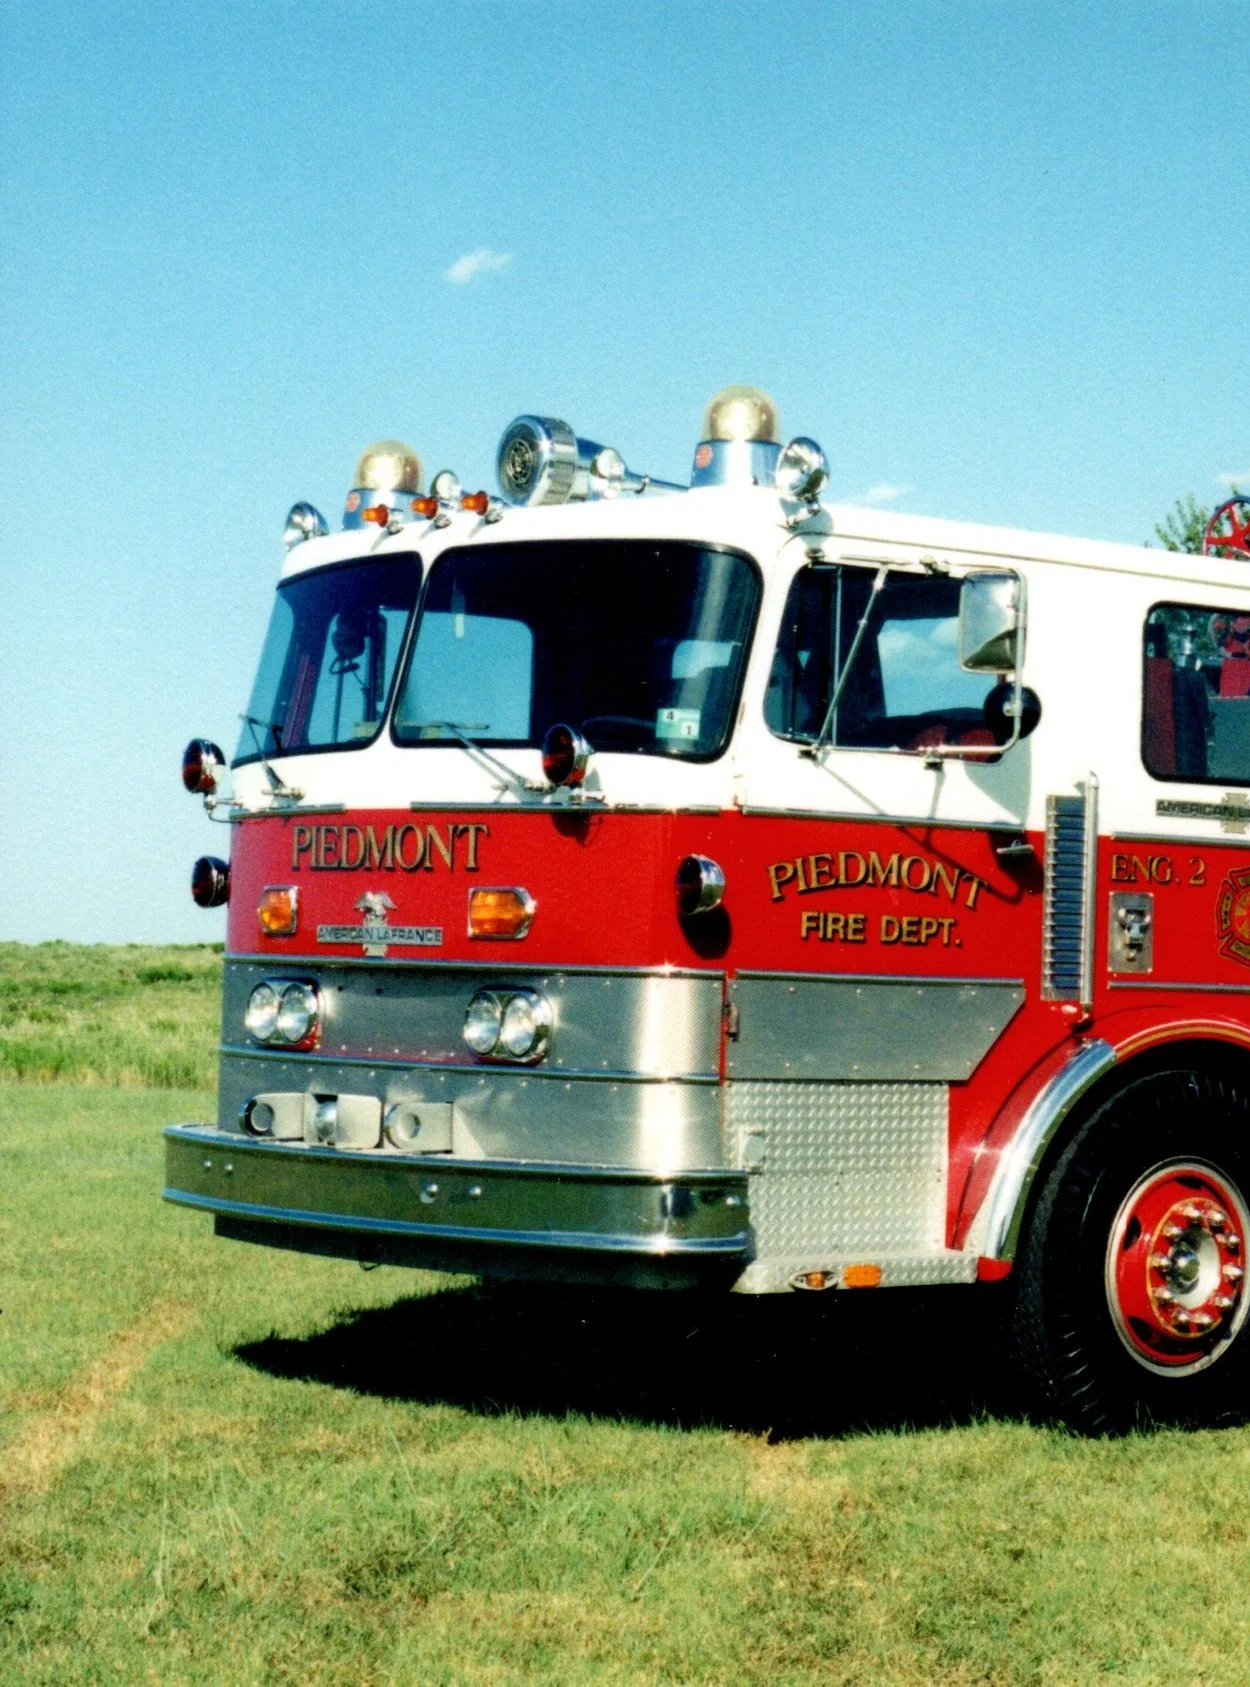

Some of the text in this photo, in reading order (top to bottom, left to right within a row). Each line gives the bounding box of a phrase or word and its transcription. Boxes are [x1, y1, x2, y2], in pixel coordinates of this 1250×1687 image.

[1156, 800, 1234, 817] AMERICAN
[292, 823, 490, 872] PIEDMONT
[767, 850, 989, 910] PIEDMONT
[1110, 854, 1181, 884] ENG.
[1188, 857, 1206, 885] 2
[318, 925, 374, 940] AMERICAN
[800, 911, 962, 947] FIRE DEPT.
